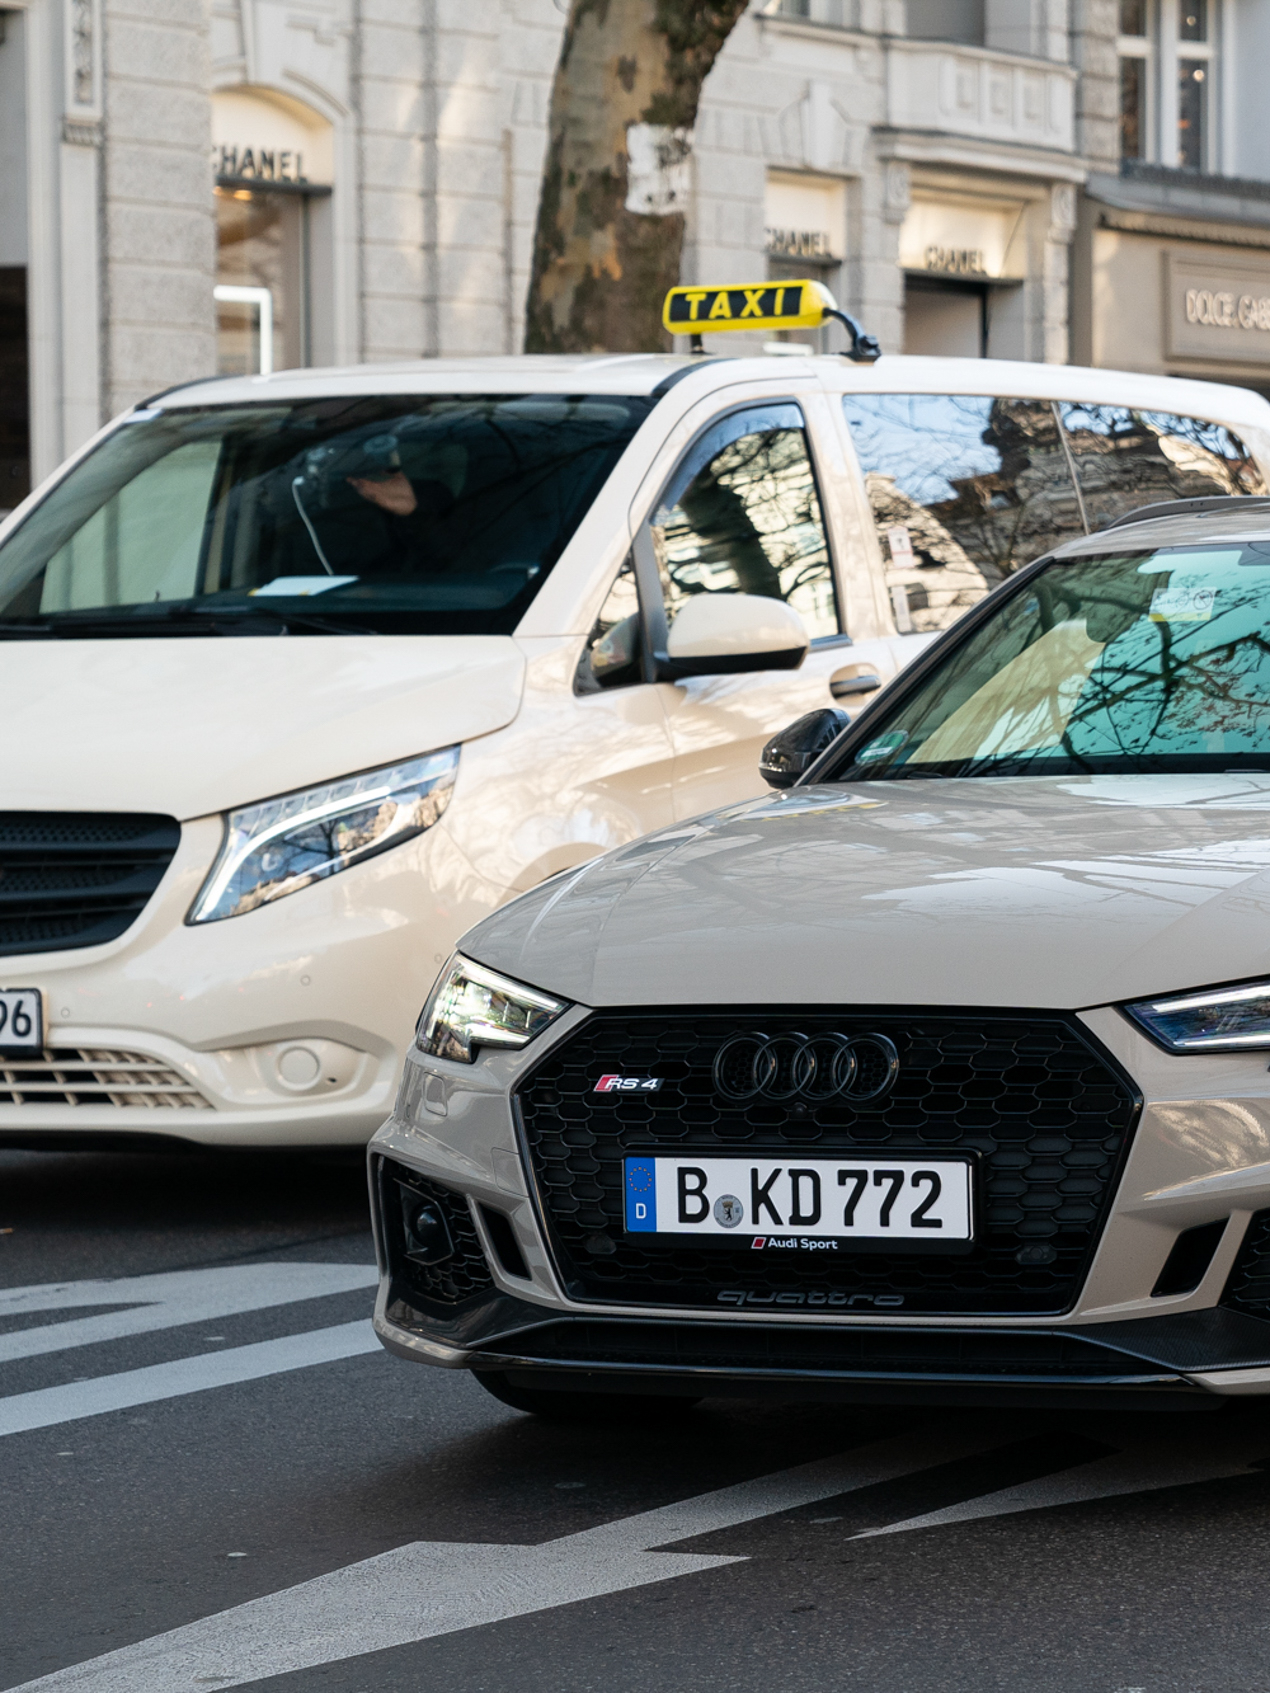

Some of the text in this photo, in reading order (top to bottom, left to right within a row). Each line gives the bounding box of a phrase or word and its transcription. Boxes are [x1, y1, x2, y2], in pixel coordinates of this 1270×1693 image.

[685, 288, 785, 321] TAXI
[604, 1078, 659, 1090] RS 4
[677, 1166, 710, 1224] B
[751, 1167, 821, 1227] KD
[837, 1169, 943, 1229] 772
[635, 1203, 646, 1219] D
[768, 1237, 838, 1251] Audi Sport
[717, 1290, 905, 1306] quattro
